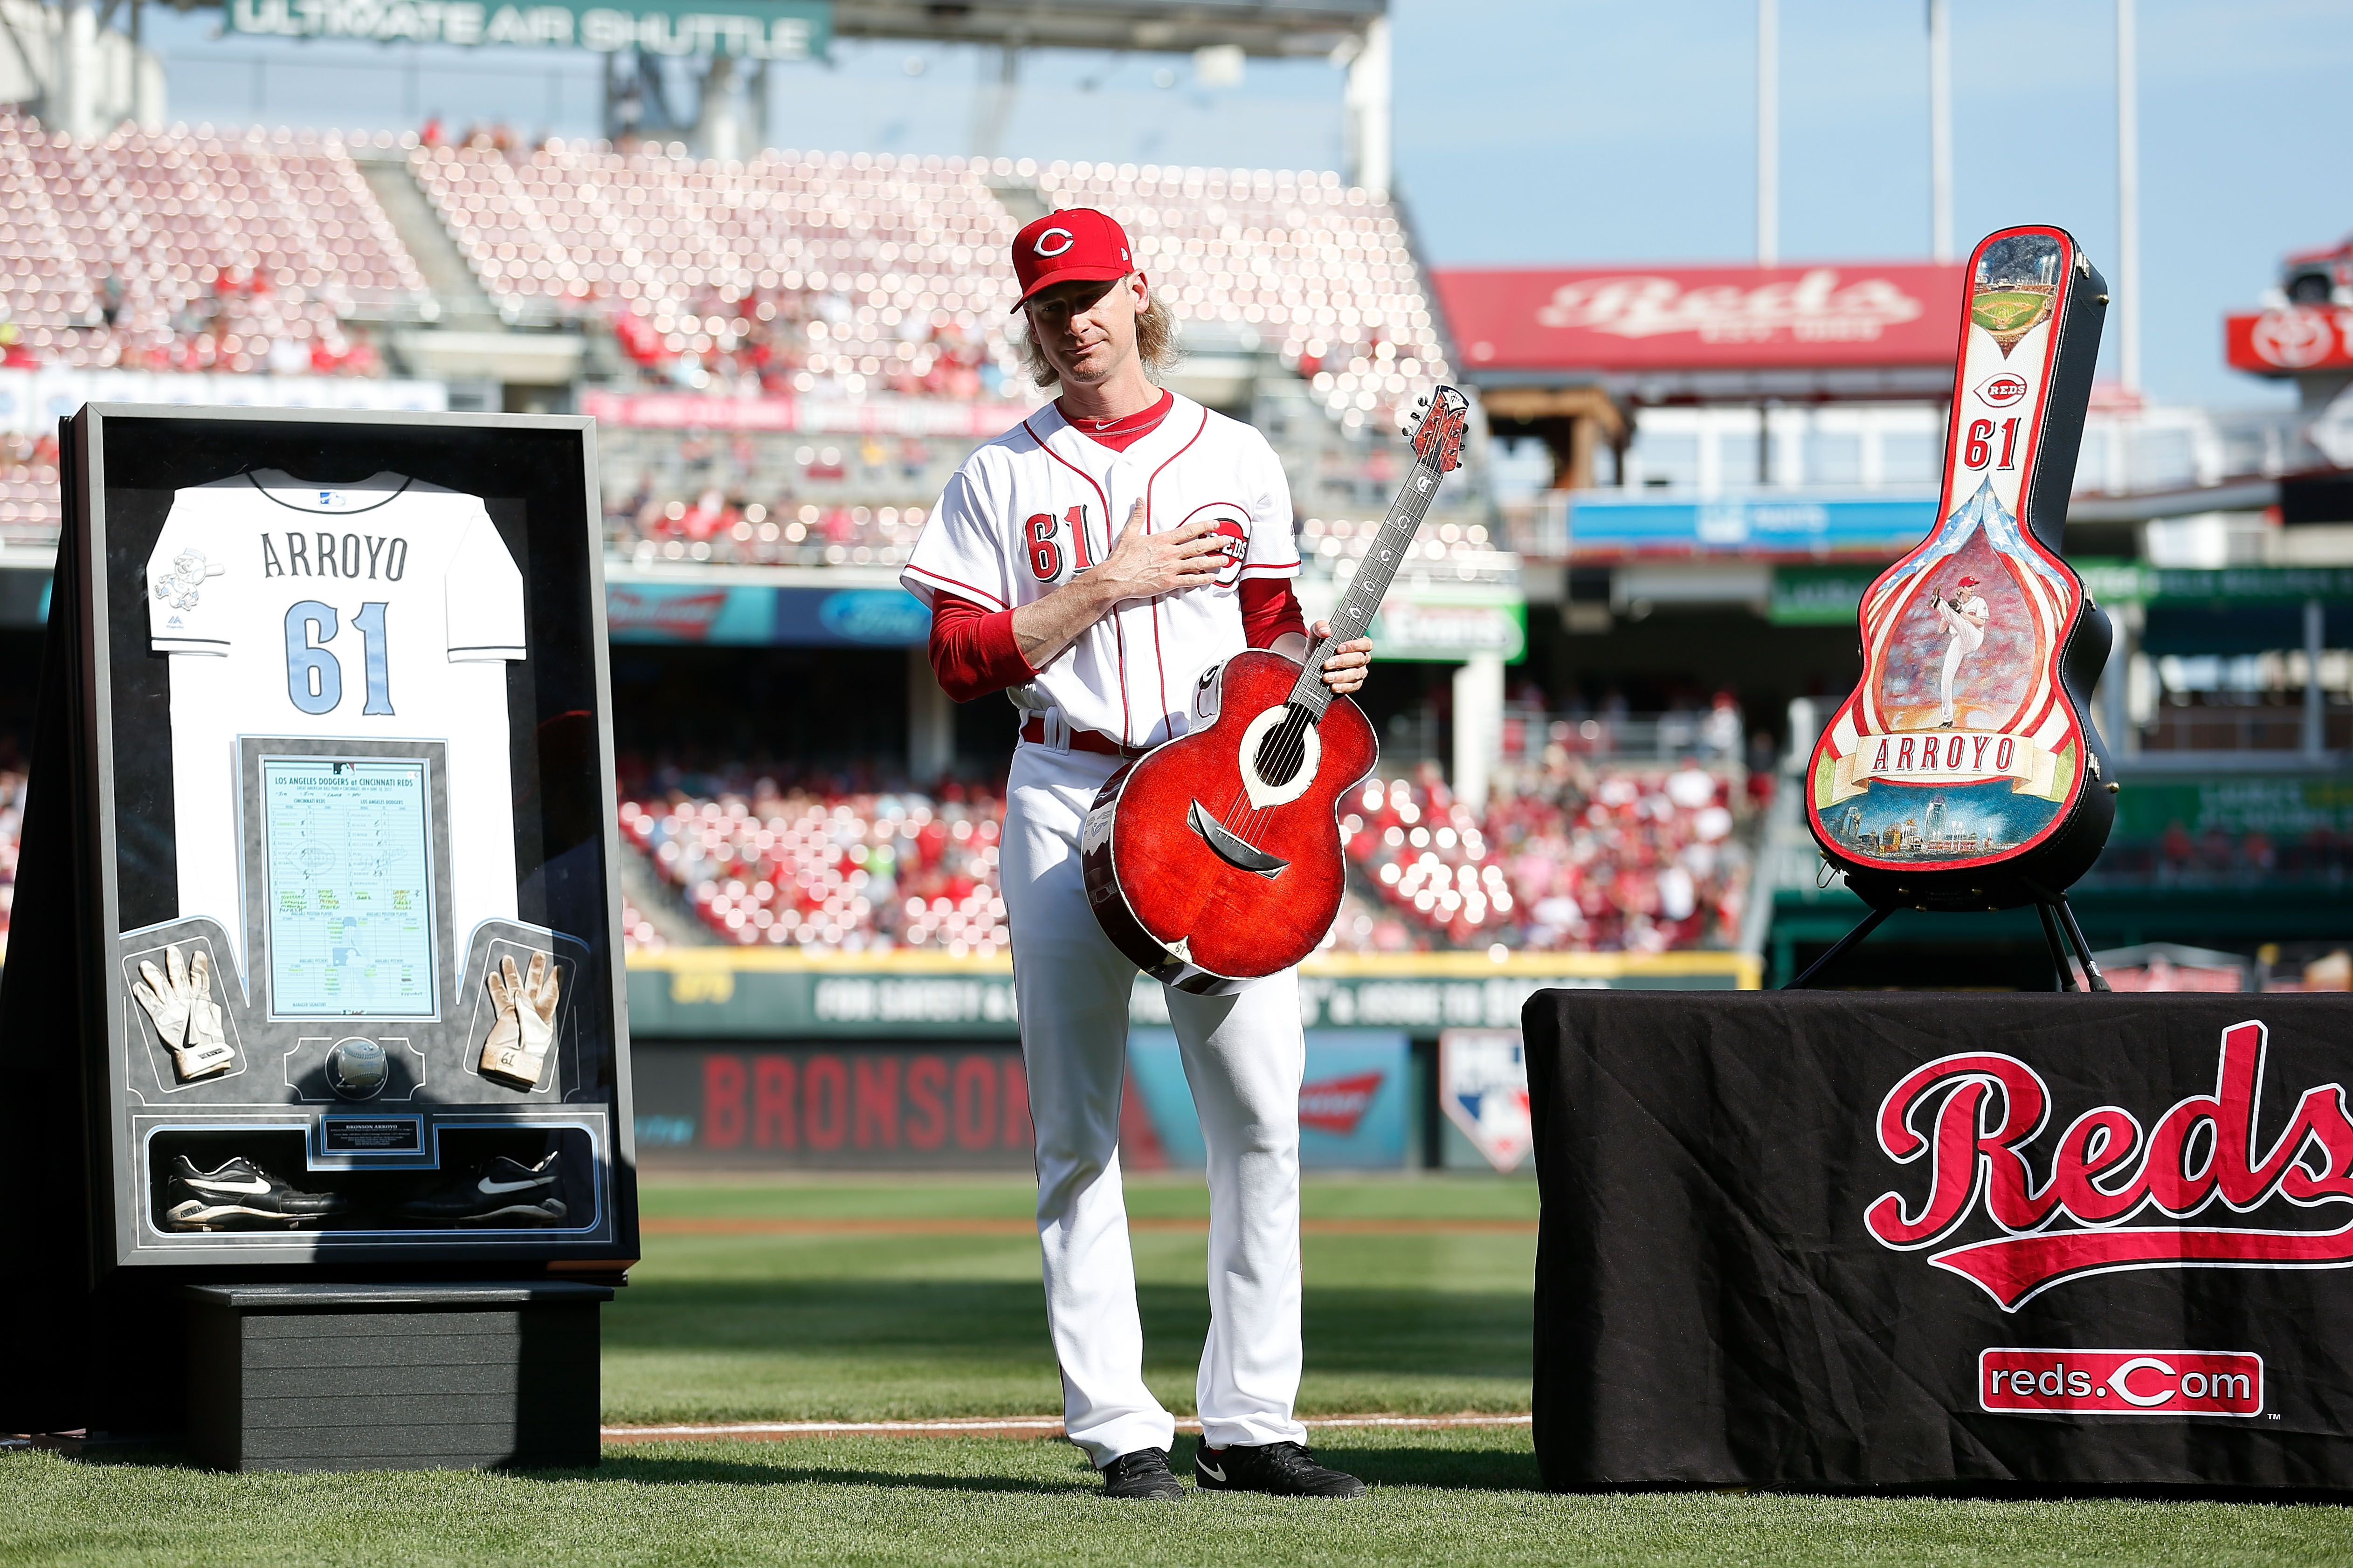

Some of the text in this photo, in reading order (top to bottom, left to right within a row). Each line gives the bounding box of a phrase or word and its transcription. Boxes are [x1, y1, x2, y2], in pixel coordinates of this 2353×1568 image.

[233, 0, 811, 61] ULTIMATE AIR SHUTTLE
[1534, 267, 1922, 339] Reds
[1989, 385, 2026, 395] REDS
[1964, 417, 2022, 471] 61
[261, 532, 408, 582] ARROYO
[1024, 504, 1095, 583] 61
[284, 600, 396, 716] 61
[1871, 736, 2015, 771] ARROYO
[319, 777, 349, 786] DODGERS
[1175, 943, 1186, 956] 61
[501, 1052, 515, 1066] 61
[702, 1054, 1033, 1151] BRONSON
[1864, 1020, 2353, 1251] Reds
[180, 1205, 203, 1218] AIR
